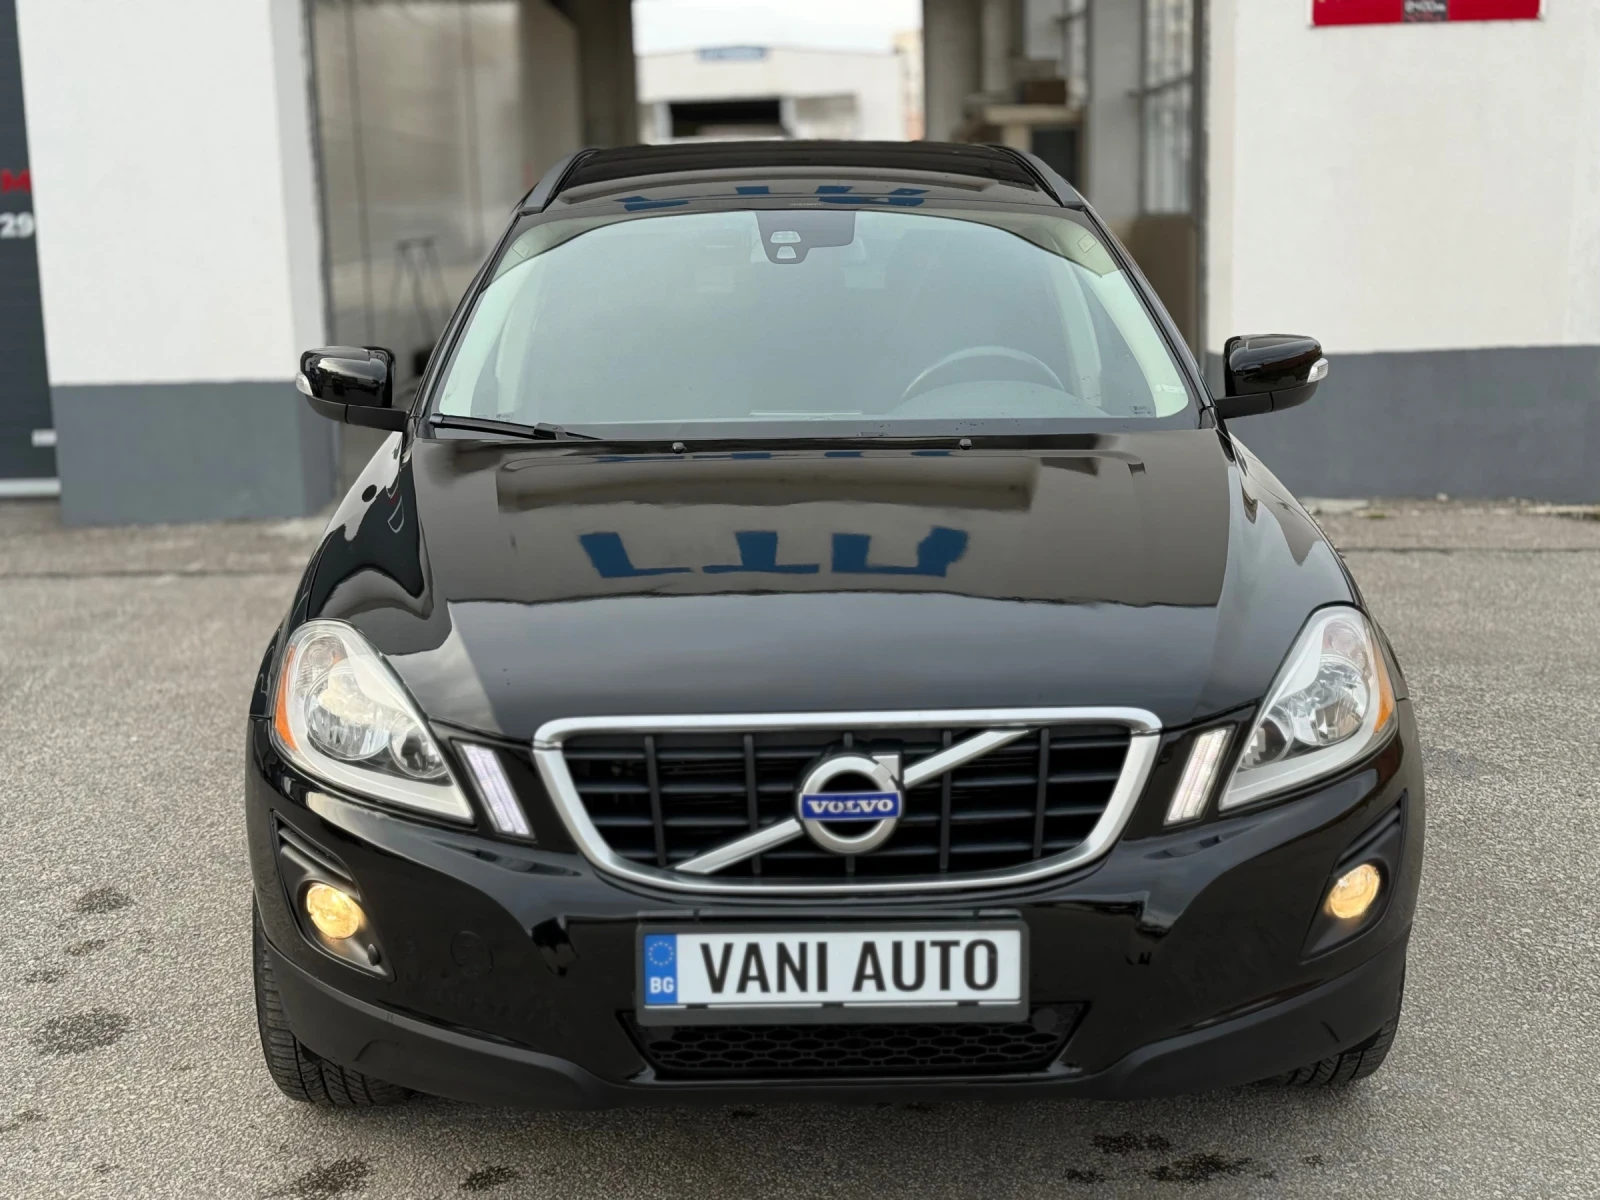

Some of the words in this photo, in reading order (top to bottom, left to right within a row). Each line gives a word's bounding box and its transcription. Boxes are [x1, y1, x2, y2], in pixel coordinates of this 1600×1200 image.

[0, 211, 35, 239] 29
[807, 799, 894, 814] VOLVO
[700, 941, 829, 994] VANI
[852, 939, 999, 993] AUTO
[649, 977, 675, 995] BG
